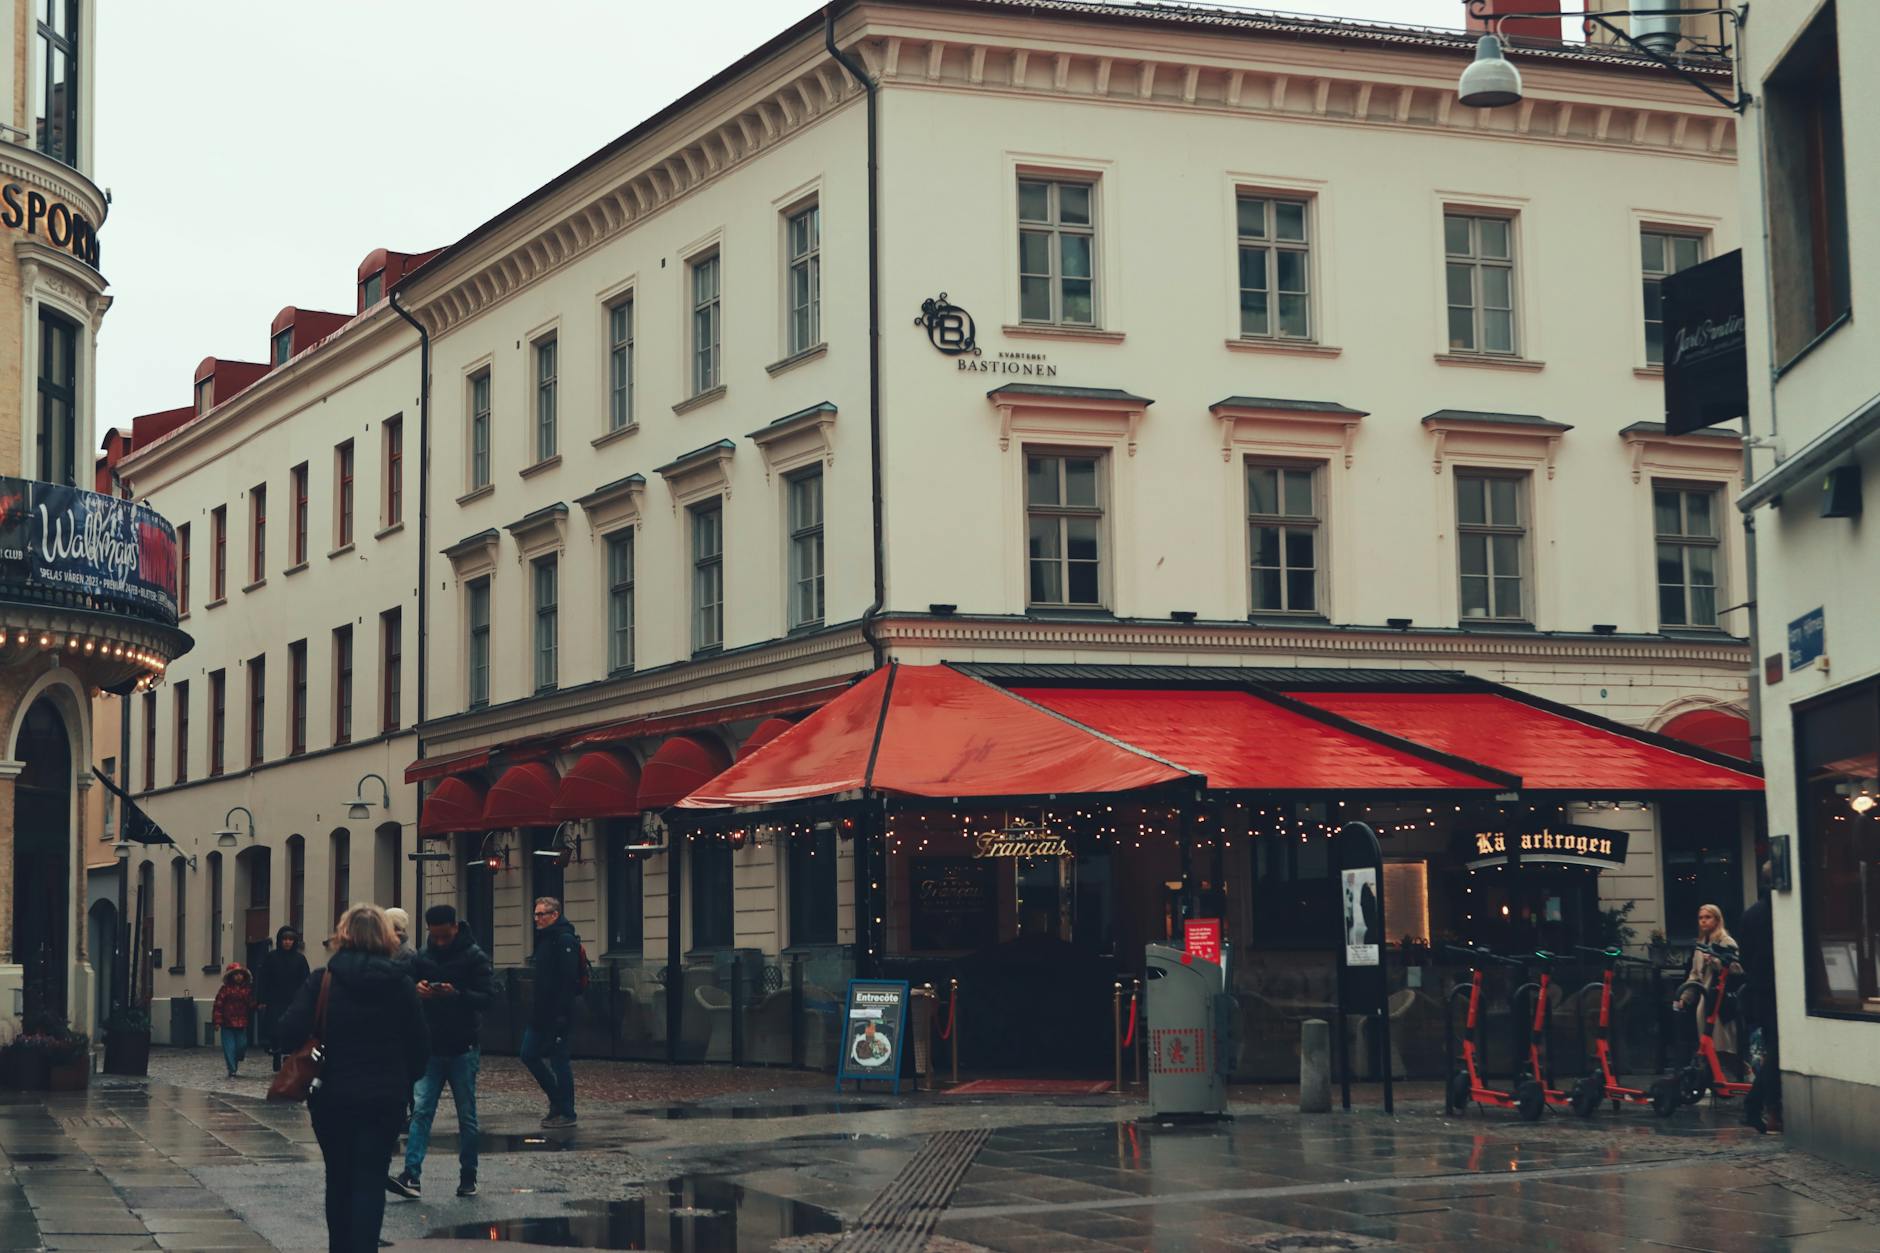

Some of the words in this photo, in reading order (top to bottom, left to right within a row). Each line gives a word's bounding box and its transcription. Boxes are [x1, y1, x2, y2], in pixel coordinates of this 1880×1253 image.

[958, 359, 1057, 377] BASTIONEN
[39, 503, 139, 572] Wallmans
[4, 549, 23, 560] CLUB
[40, 568, 63, 581] SPELAS
[64, 569, 84, 584] VÅREN
[85, 575, 99, 587] 2023
[856, 992, 899, 1002] Entrecôte
